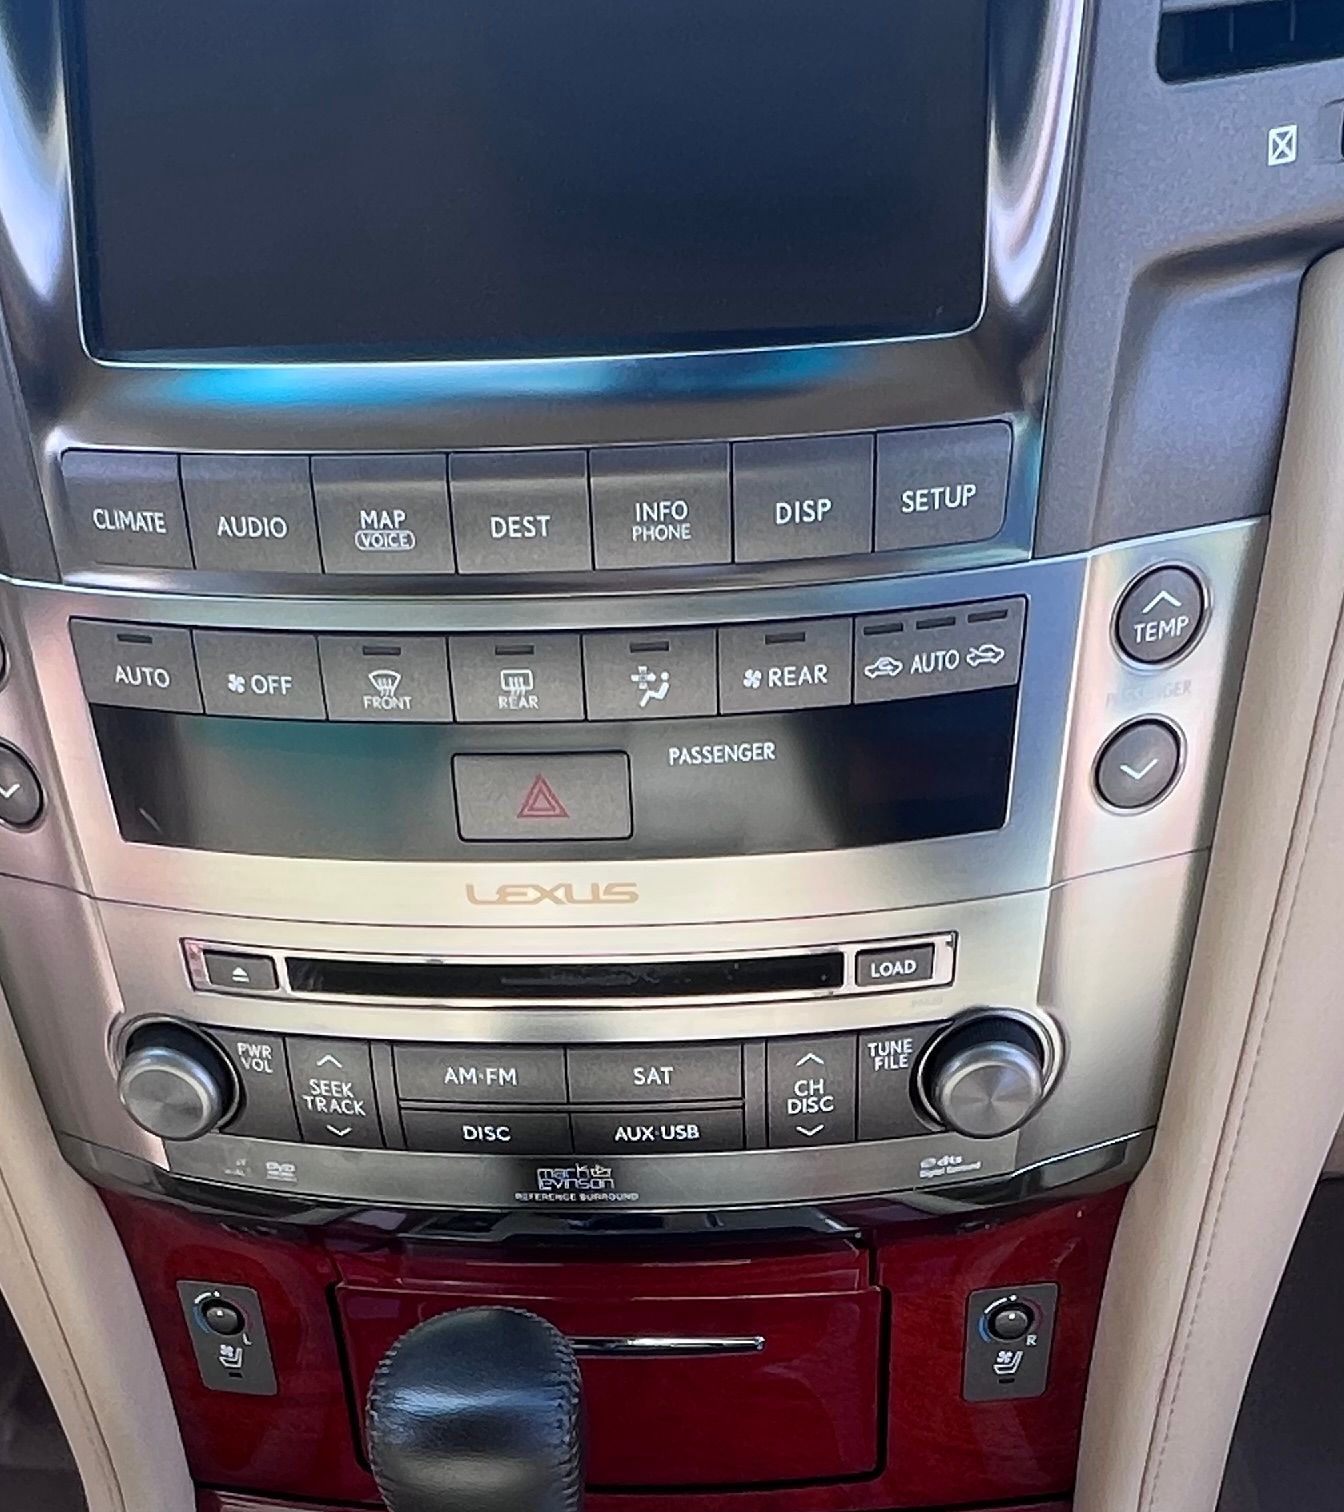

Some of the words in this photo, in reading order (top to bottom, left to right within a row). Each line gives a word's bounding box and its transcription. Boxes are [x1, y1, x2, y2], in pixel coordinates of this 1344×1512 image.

[901, 485, 976, 513] SETUP
[93, 508, 166, 534] CLIMATE
[360, 510, 406, 529] MAP
[635, 501, 688, 522] INFO
[775, 499, 831, 524] DISP
[217, 516, 287, 538] AUDIO
[490, 516, 550, 537] DEST
[632, 523, 691, 541] PHONE
[361, 532, 409, 548] VOICE
[1134, 616, 1189, 643] TEMP
[910, 650, 959, 674] AUTO
[114, 665, 169, 687] AUTO
[251, 675, 292, 694] OFF
[768, 665, 827, 687] REAR
[363, 696, 411, 709] FRONT
[499, 696, 538, 708] REAR
[669, 743, 775, 765] PASSENGER
[466, 883, 639, 905] LEXUS
[871, 960, 916, 977] LOAD
[237, 1043, 271, 1059] PWR
[868, 1039, 912, 1057] TUNE
[241, 1060, 273, 1073] VOL
[874, 1056, 908, 1071] FILE
[633, 1067, 673, 1085] SAT
[310, 1079, 353, 1098] SEEK
[794, 1079, 823, 1096] CH
[304, 1096, 366, 1116] TRACK
[788, 1097, 834, 1114] DISC
[463, 1126, 511, 1141] DISC
